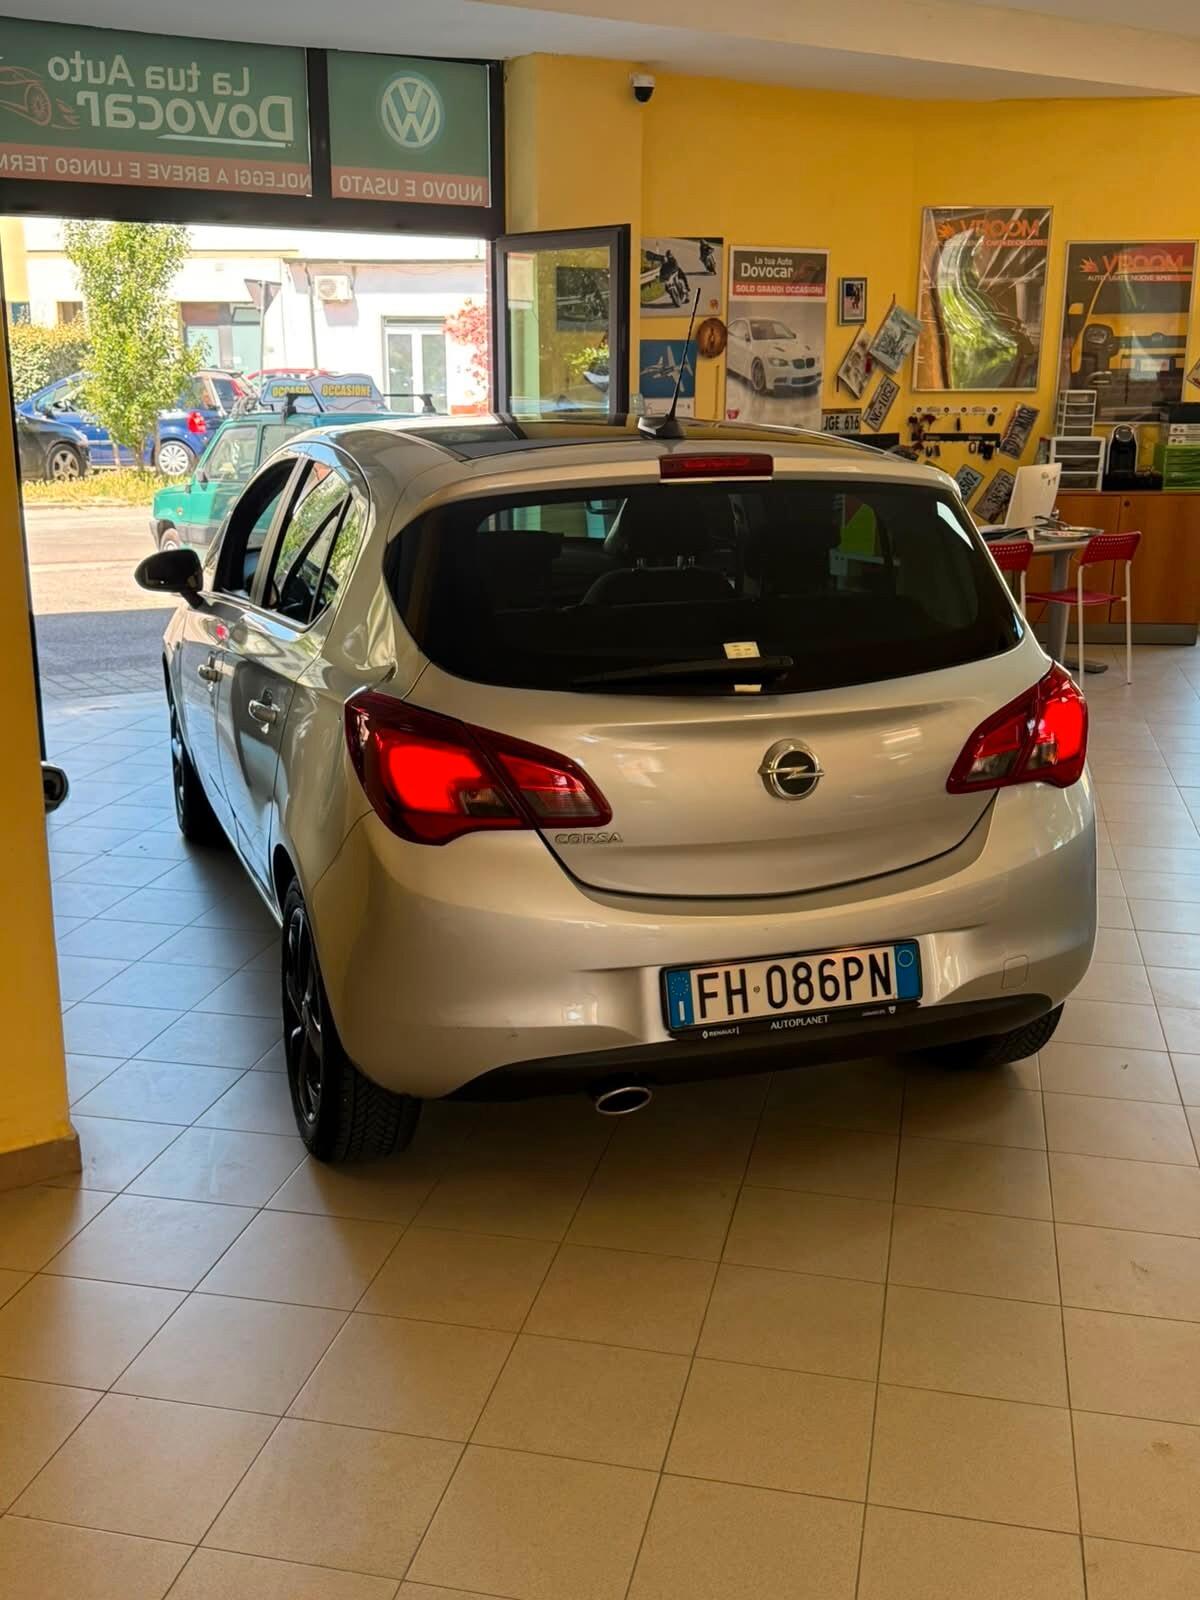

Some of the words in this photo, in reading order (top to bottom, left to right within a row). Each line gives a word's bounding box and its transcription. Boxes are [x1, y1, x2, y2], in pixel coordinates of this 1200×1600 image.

[960, 219, 1040, 237] VROOM
[754, 256, 764, 265] La
[764, 257, 776, 266] tua
[777, 257, 793, 266] Auto
[1102, 255, 1184, 273] VROOM
[740, 263, 794, 278] Dovocar
[735, 284, 756, 293] SOLO
[757, 285, 785, 293] GRANDI
[785, 285, 823, 294] OCCASIONI
[321, 383, 372, 398] OCCASIONE
[823, 415, 840, 431] JGE
[844, 415, 860, 431] 616
[555, 832, 624, 845] CORSA
[697, 968, 750, 1019] FH
[765, 951, 892, 1010] 086PN
[770, 1014, 830, 1031] AUTOPLANET
